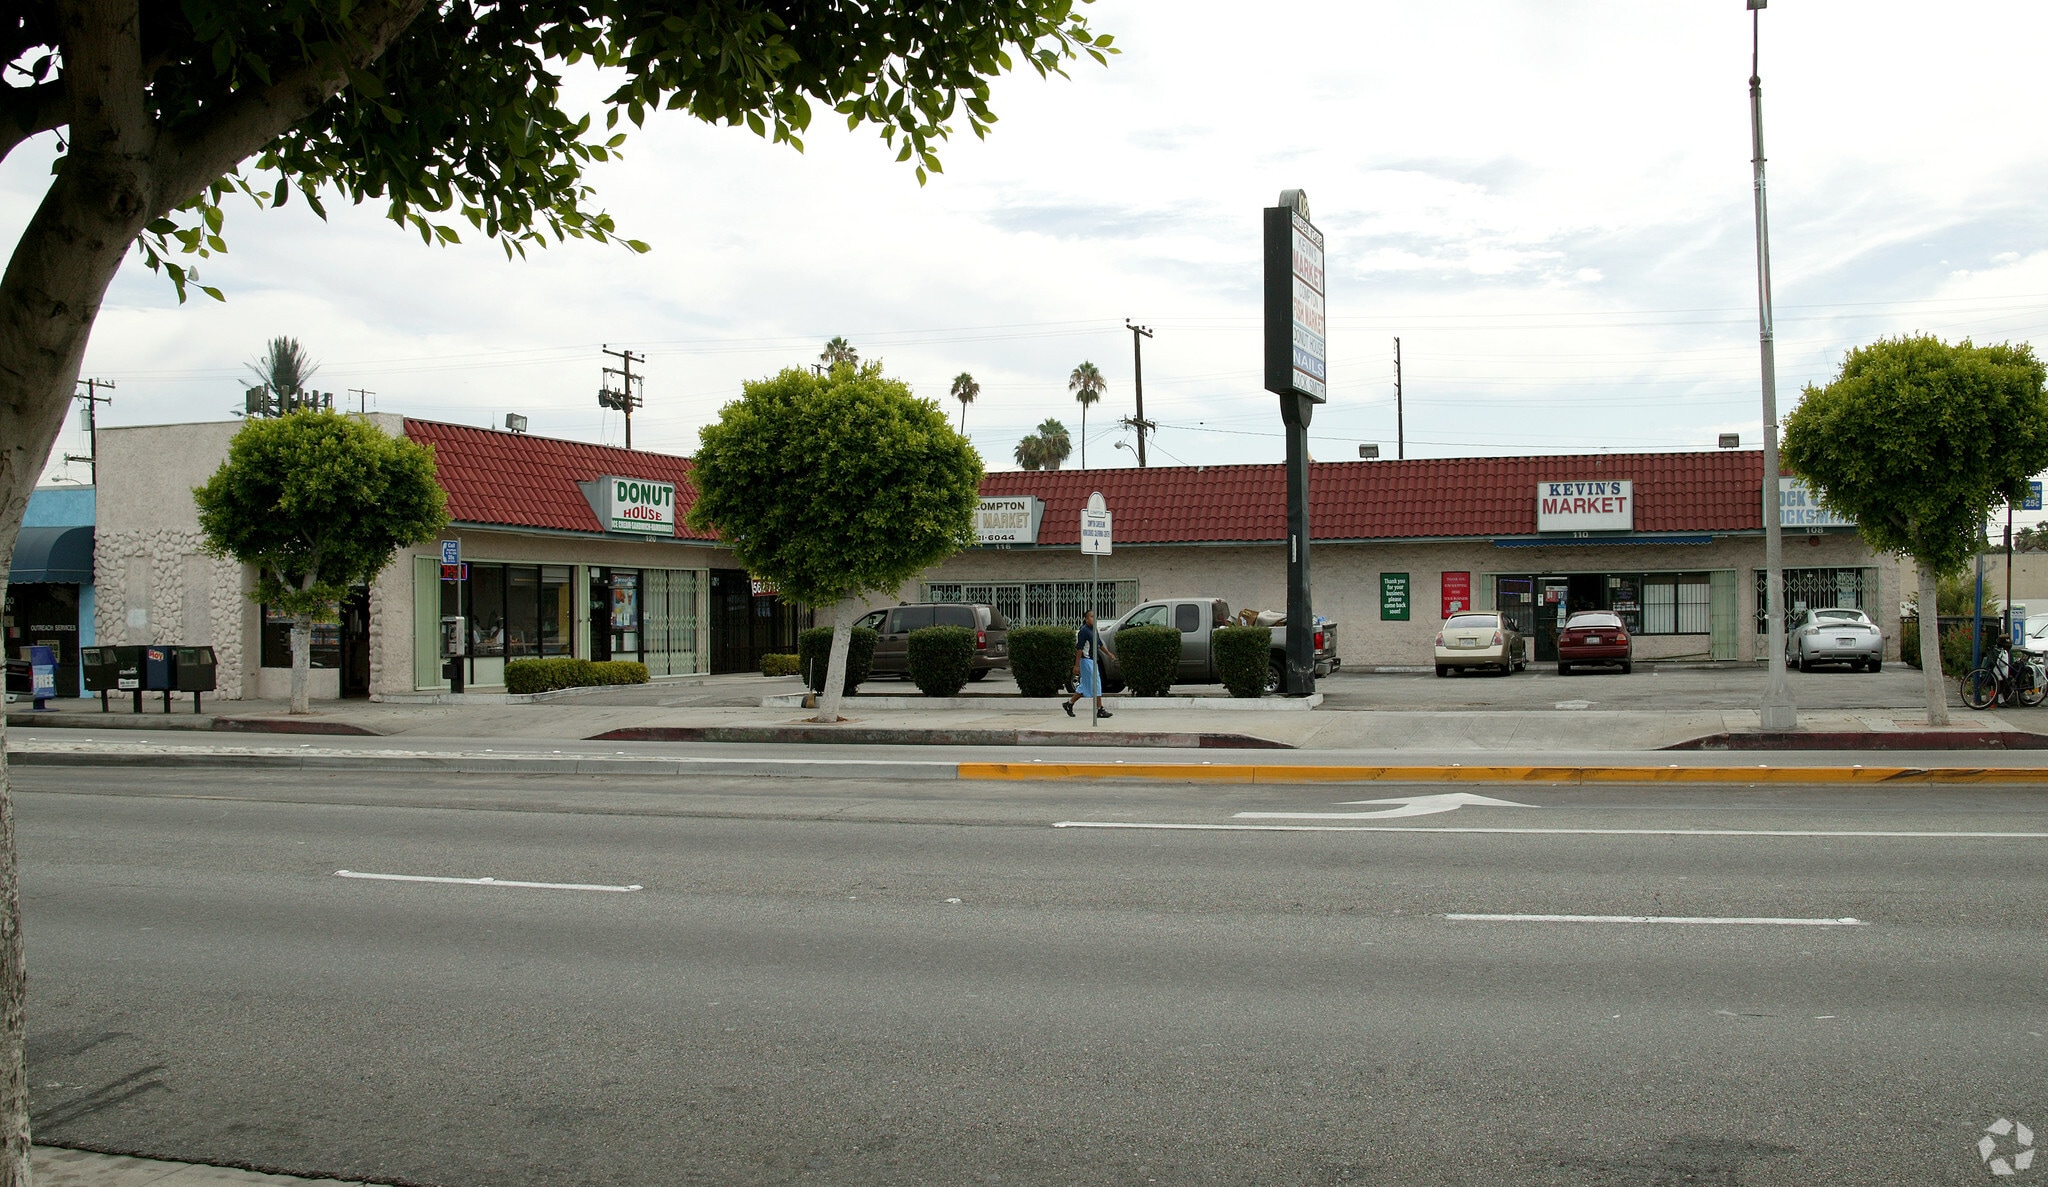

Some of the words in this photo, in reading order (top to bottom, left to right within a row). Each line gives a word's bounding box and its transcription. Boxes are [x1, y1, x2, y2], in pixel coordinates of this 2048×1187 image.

[1294, 247, 1323, 291] MARKET
[1305, 304, 1323, 336] MARKET
[1310, 334, 1323, 358] HOUSE
[1293, 350, 1324, 377] NAILS
[618, 481, 673, 507] DONUT
[1549, 482, 1621, 497] KEVIN'S
[976, 502, 1025, 511] OMPTON
[1542, 497, 1627, 514] MARKET
[1779, 490, 1806, 507] OCK
[623, 505, 663, 521] HOUSE
[983, 512, 1030, 529] MARKET
[646, 535, 657, 543] 120
[54, 624, 76, 632] SERVICES
[33, 673, 54, 689] FREE
